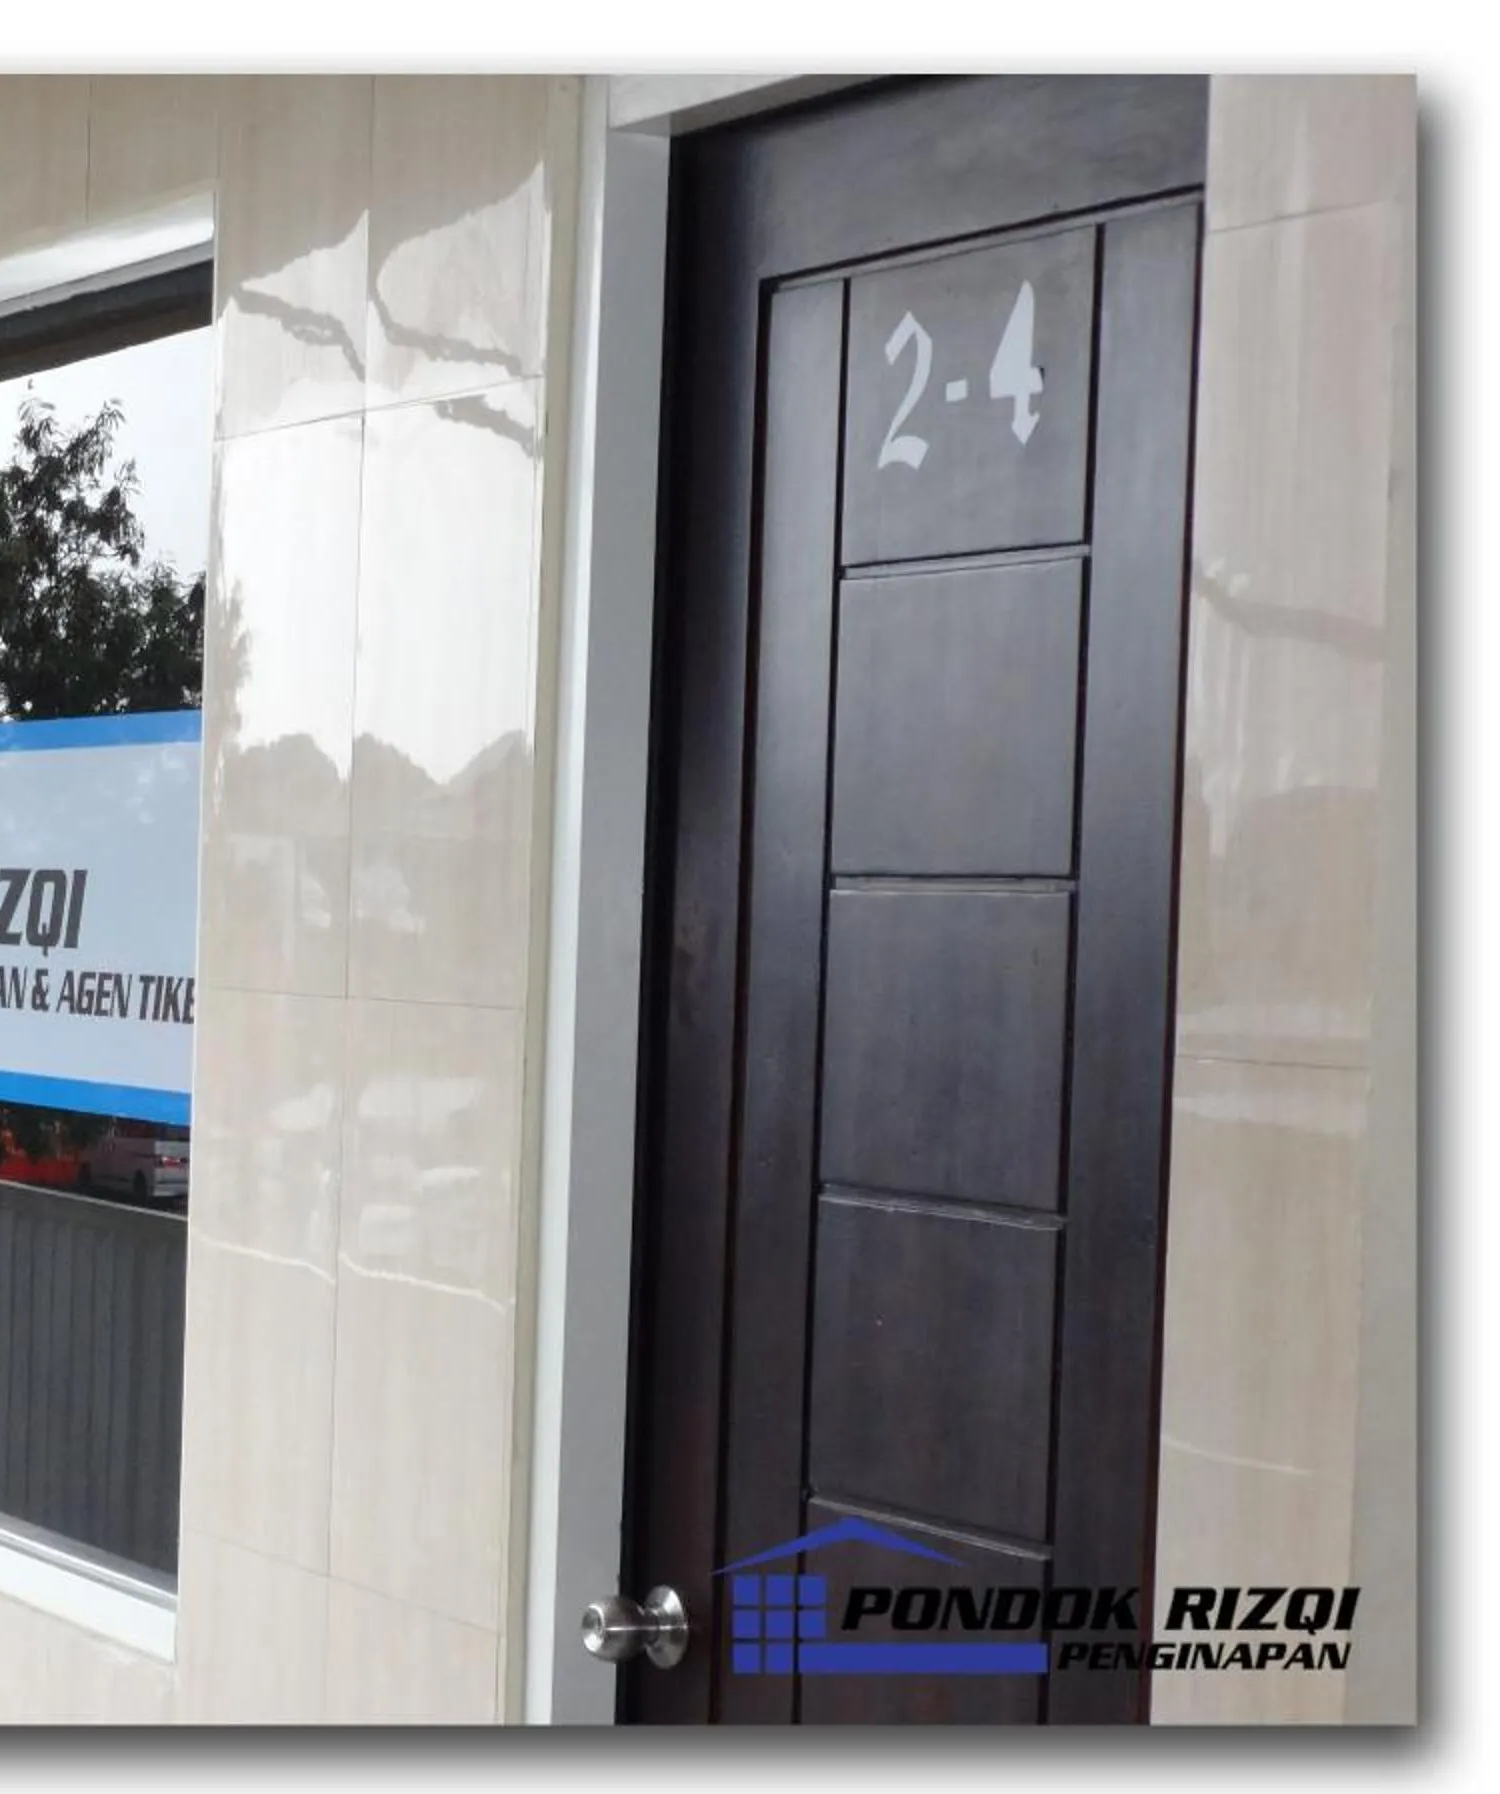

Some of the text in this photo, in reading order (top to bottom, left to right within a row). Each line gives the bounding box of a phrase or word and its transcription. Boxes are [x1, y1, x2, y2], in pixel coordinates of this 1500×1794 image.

[877, 279, 1045, 470] 2-4
[31, 968, 50, 1012] &
[56, 970, 133, 1019] AGEN
